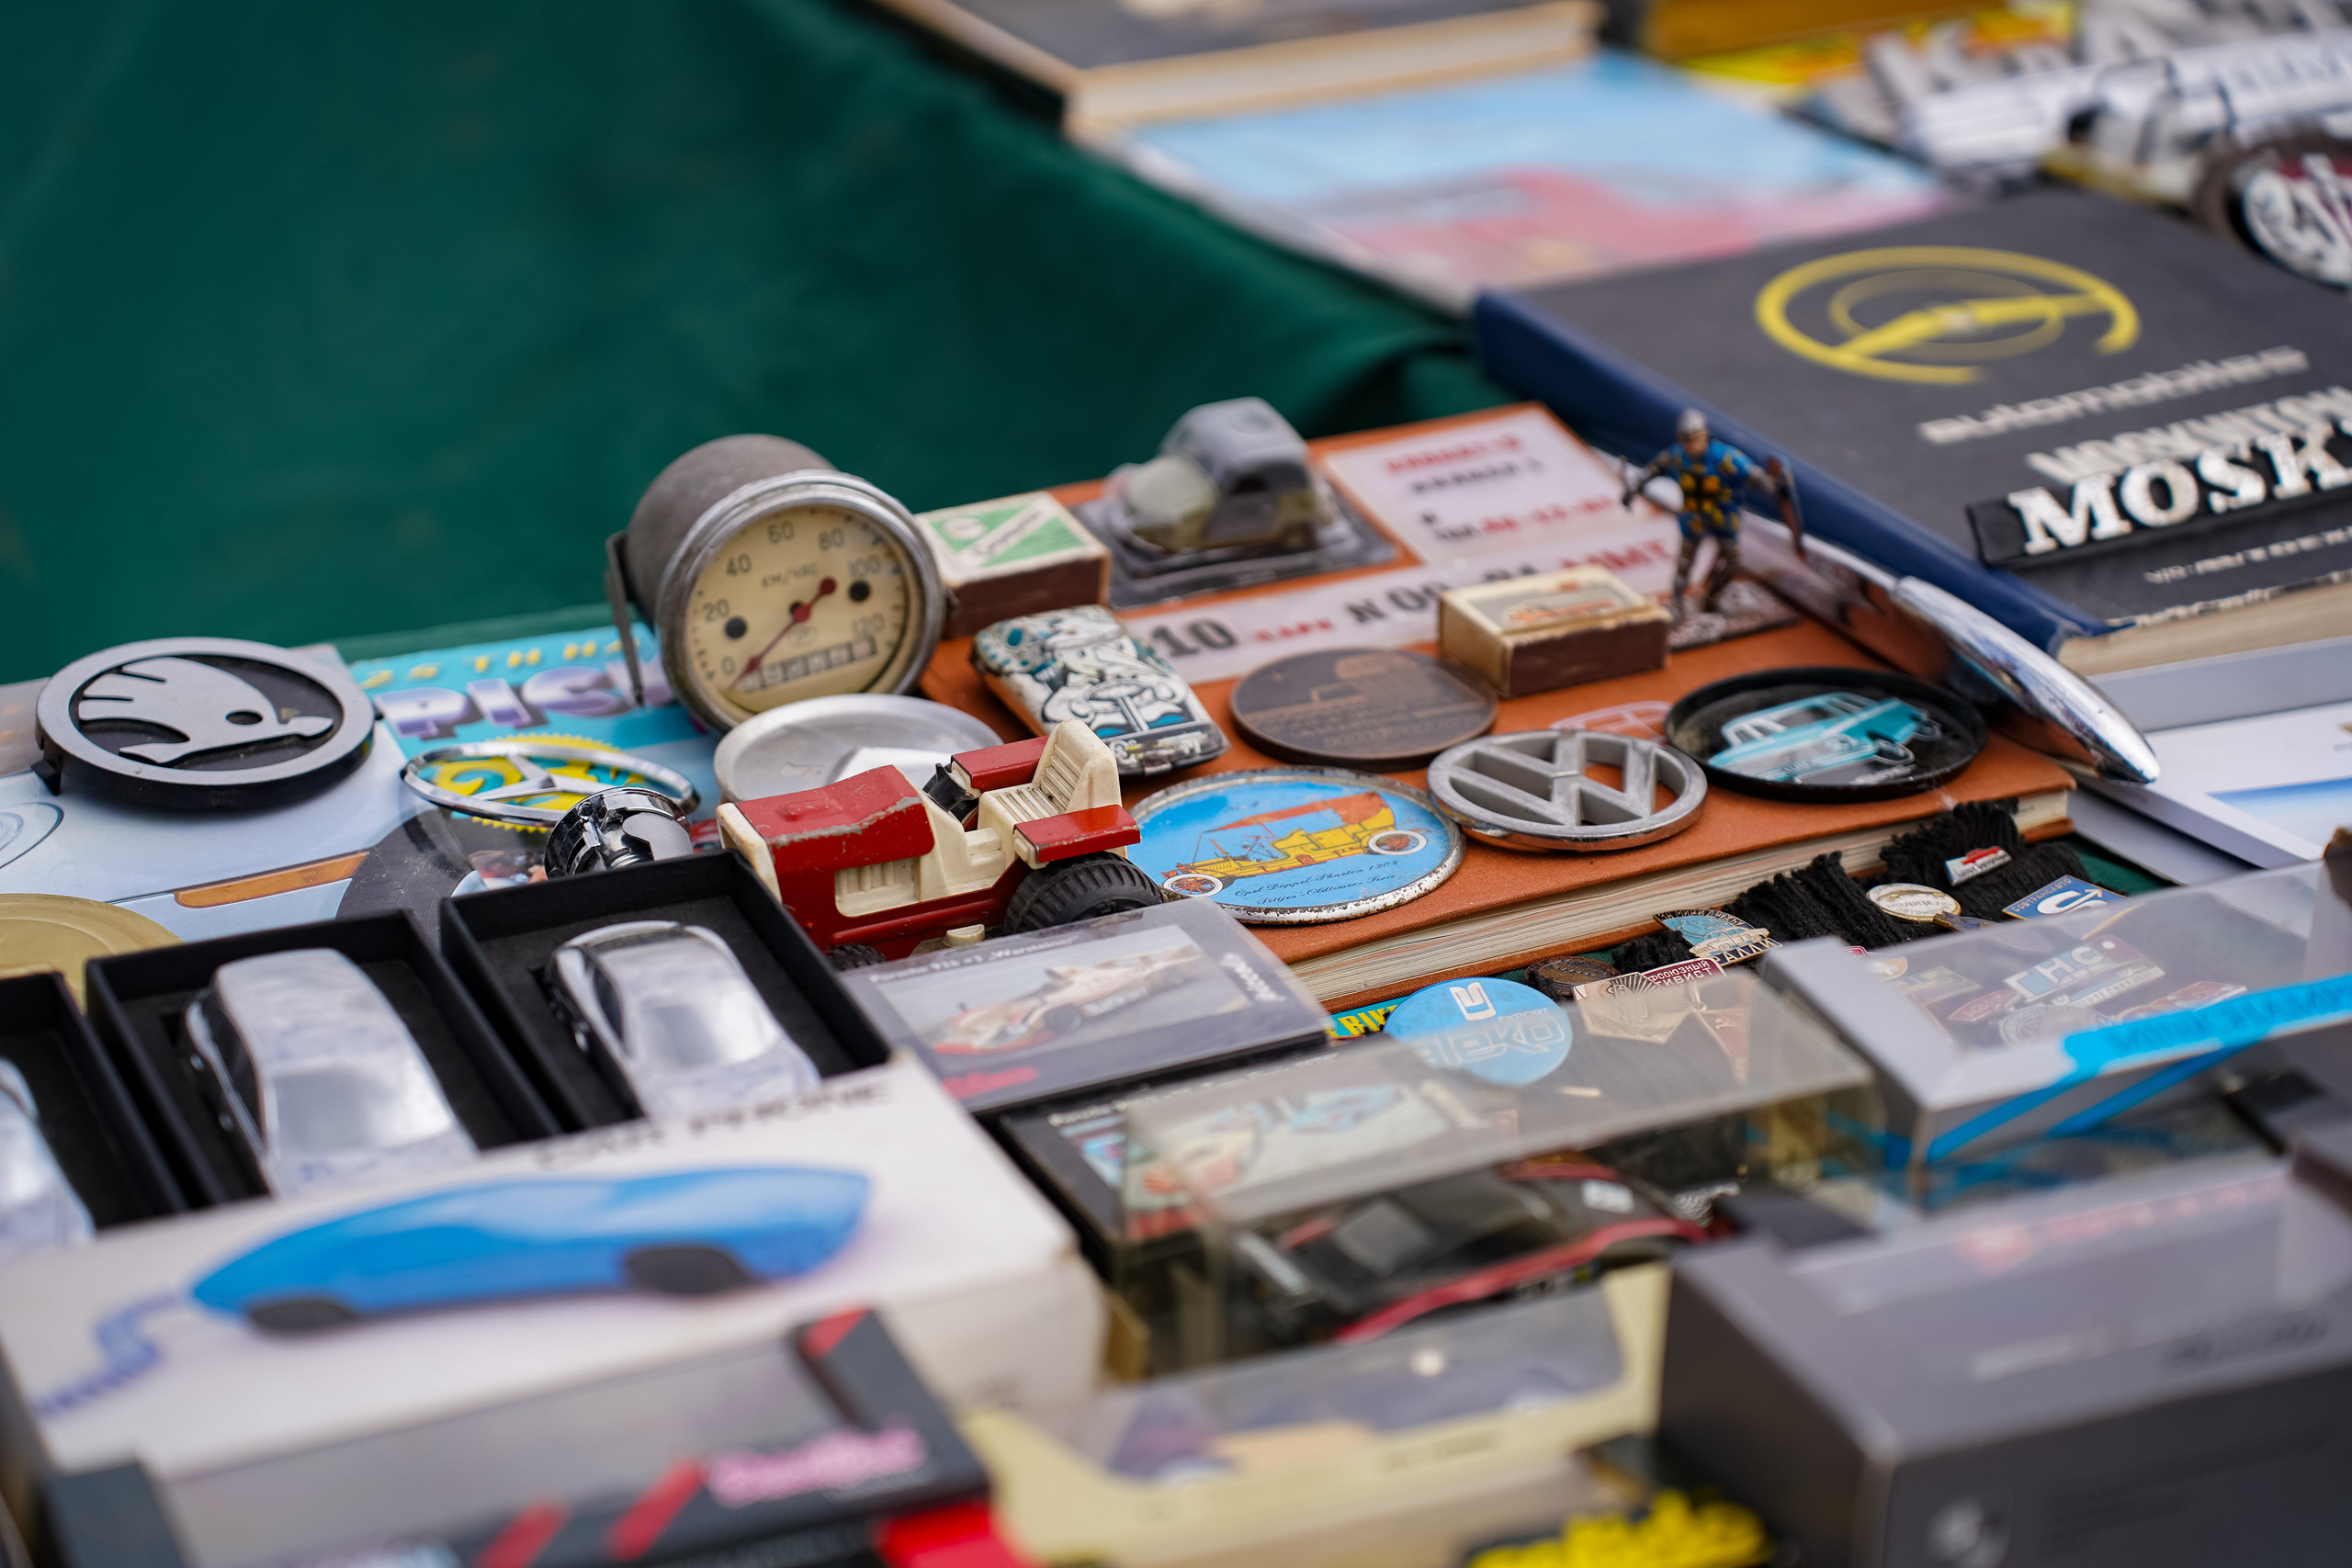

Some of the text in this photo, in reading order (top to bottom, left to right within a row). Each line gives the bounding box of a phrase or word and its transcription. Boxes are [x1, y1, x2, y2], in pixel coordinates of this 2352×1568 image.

[2007, 418, 2352, 555] MOSK
[768, 521, 795, 543] 60
[819, 528, 844, 550] 80
[727, 554, 752, 577] 40
[704, 599, 729, 622] 20
[1150, 618, 1239, 658] 10
[721, 657, 735, 676] 0
[1235, 887, 1266, 897] Opel
